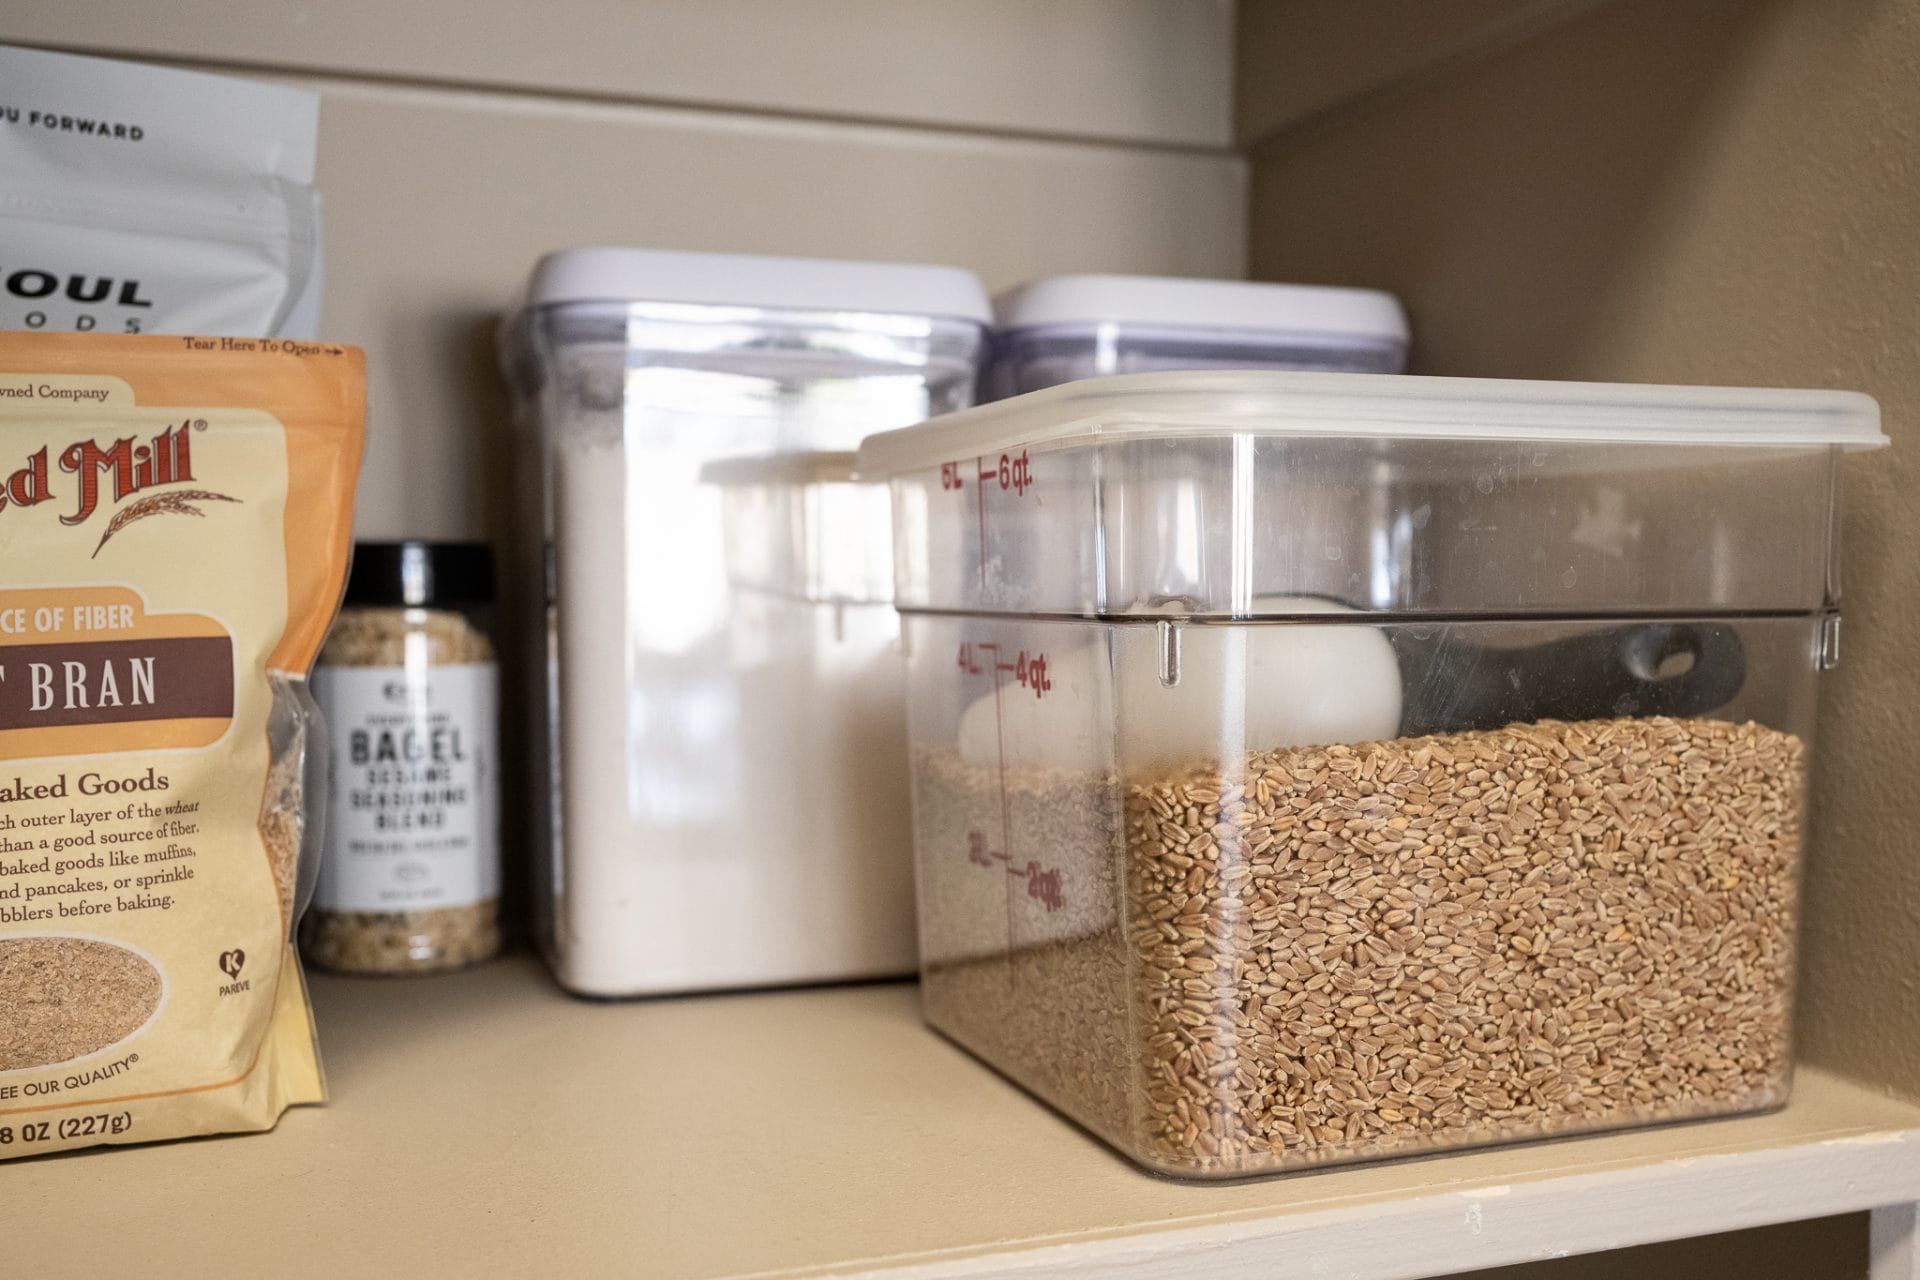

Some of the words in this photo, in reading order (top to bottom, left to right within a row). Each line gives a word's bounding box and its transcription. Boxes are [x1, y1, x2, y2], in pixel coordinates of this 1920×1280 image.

[29, 110, 144, 141] FORWARD
[183, 336, 216, 349] Tear
[221, 337, 254, 352] Here
[259, 339, 278, 352] To
[282, 340, 320, 356] Open
[38, 384, 110, 402] Company
[34, 606, 64, 633] OF
[73, 604, 135, 631] FIBER
[28, 656, 156, 711] BRAN
[0, 773, 69, 803] aked
[78, 768, 169, 796] Goods
[21, 814, 65, 828] outer
[70, 808, 112, 827] layer
[117, 803, 134, 820] of
[137, 802, 162, 818] the
[165, 799, 200, 815] wheat
[39, 839, 49, 849] a
[53, 829, 96, 852] good
[100, 830, 154, 844] source
[156, 822, 168, 839] of
[170, 820, 199, 837] fiber.
[55, 852, 105, 875] goods
[109, 850, 139, 867] like
[144, 843, 196, 863] muffins,
[25, 877, 108, 901] pancakes,
[113, 878, 131, 889] or
[136, 864, 194, 890] sprinkle
[58, 899, 112, 918] before
[116, 893, 176, 912] baking.
[219, 980, 250, 997] PAREVE
[23, 1080, 60, 1096] OUR
[0, 1126, 14, 1144] 8
[22, 1122, 50, 1142] OZ
[58, 1111, 132, 1139] (227g)
